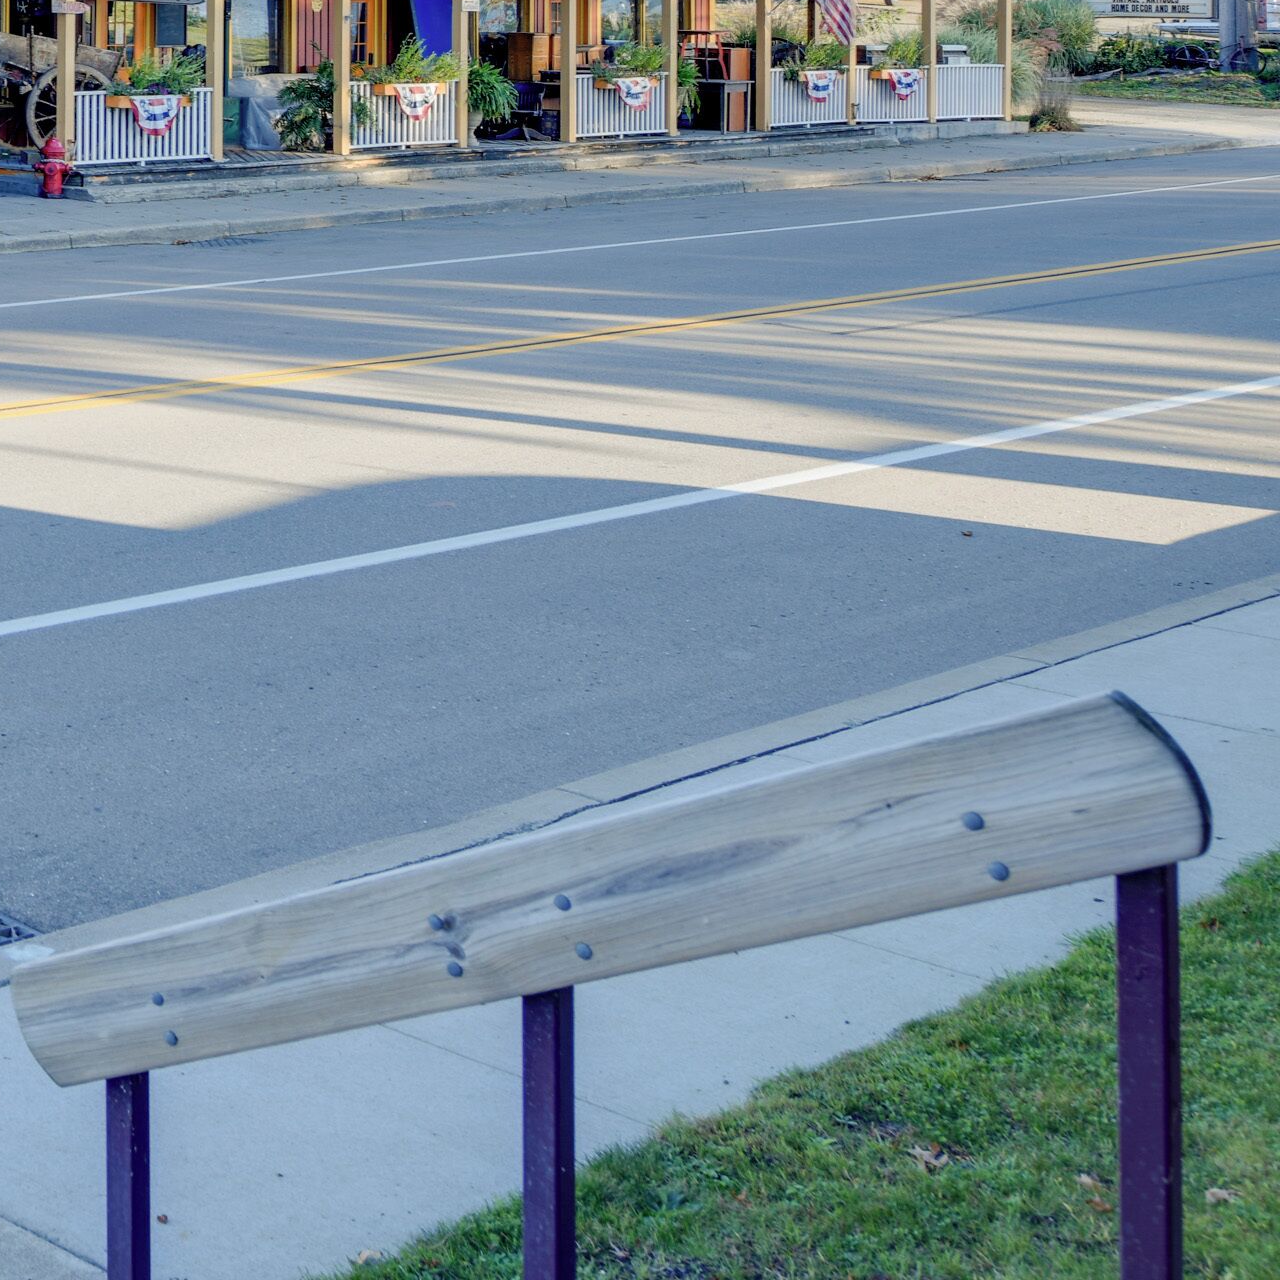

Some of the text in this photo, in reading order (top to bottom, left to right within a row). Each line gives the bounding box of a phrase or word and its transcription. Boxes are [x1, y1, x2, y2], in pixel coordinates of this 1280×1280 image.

[1111, 4, 1190, 13] HOME DECOR AND MORE
